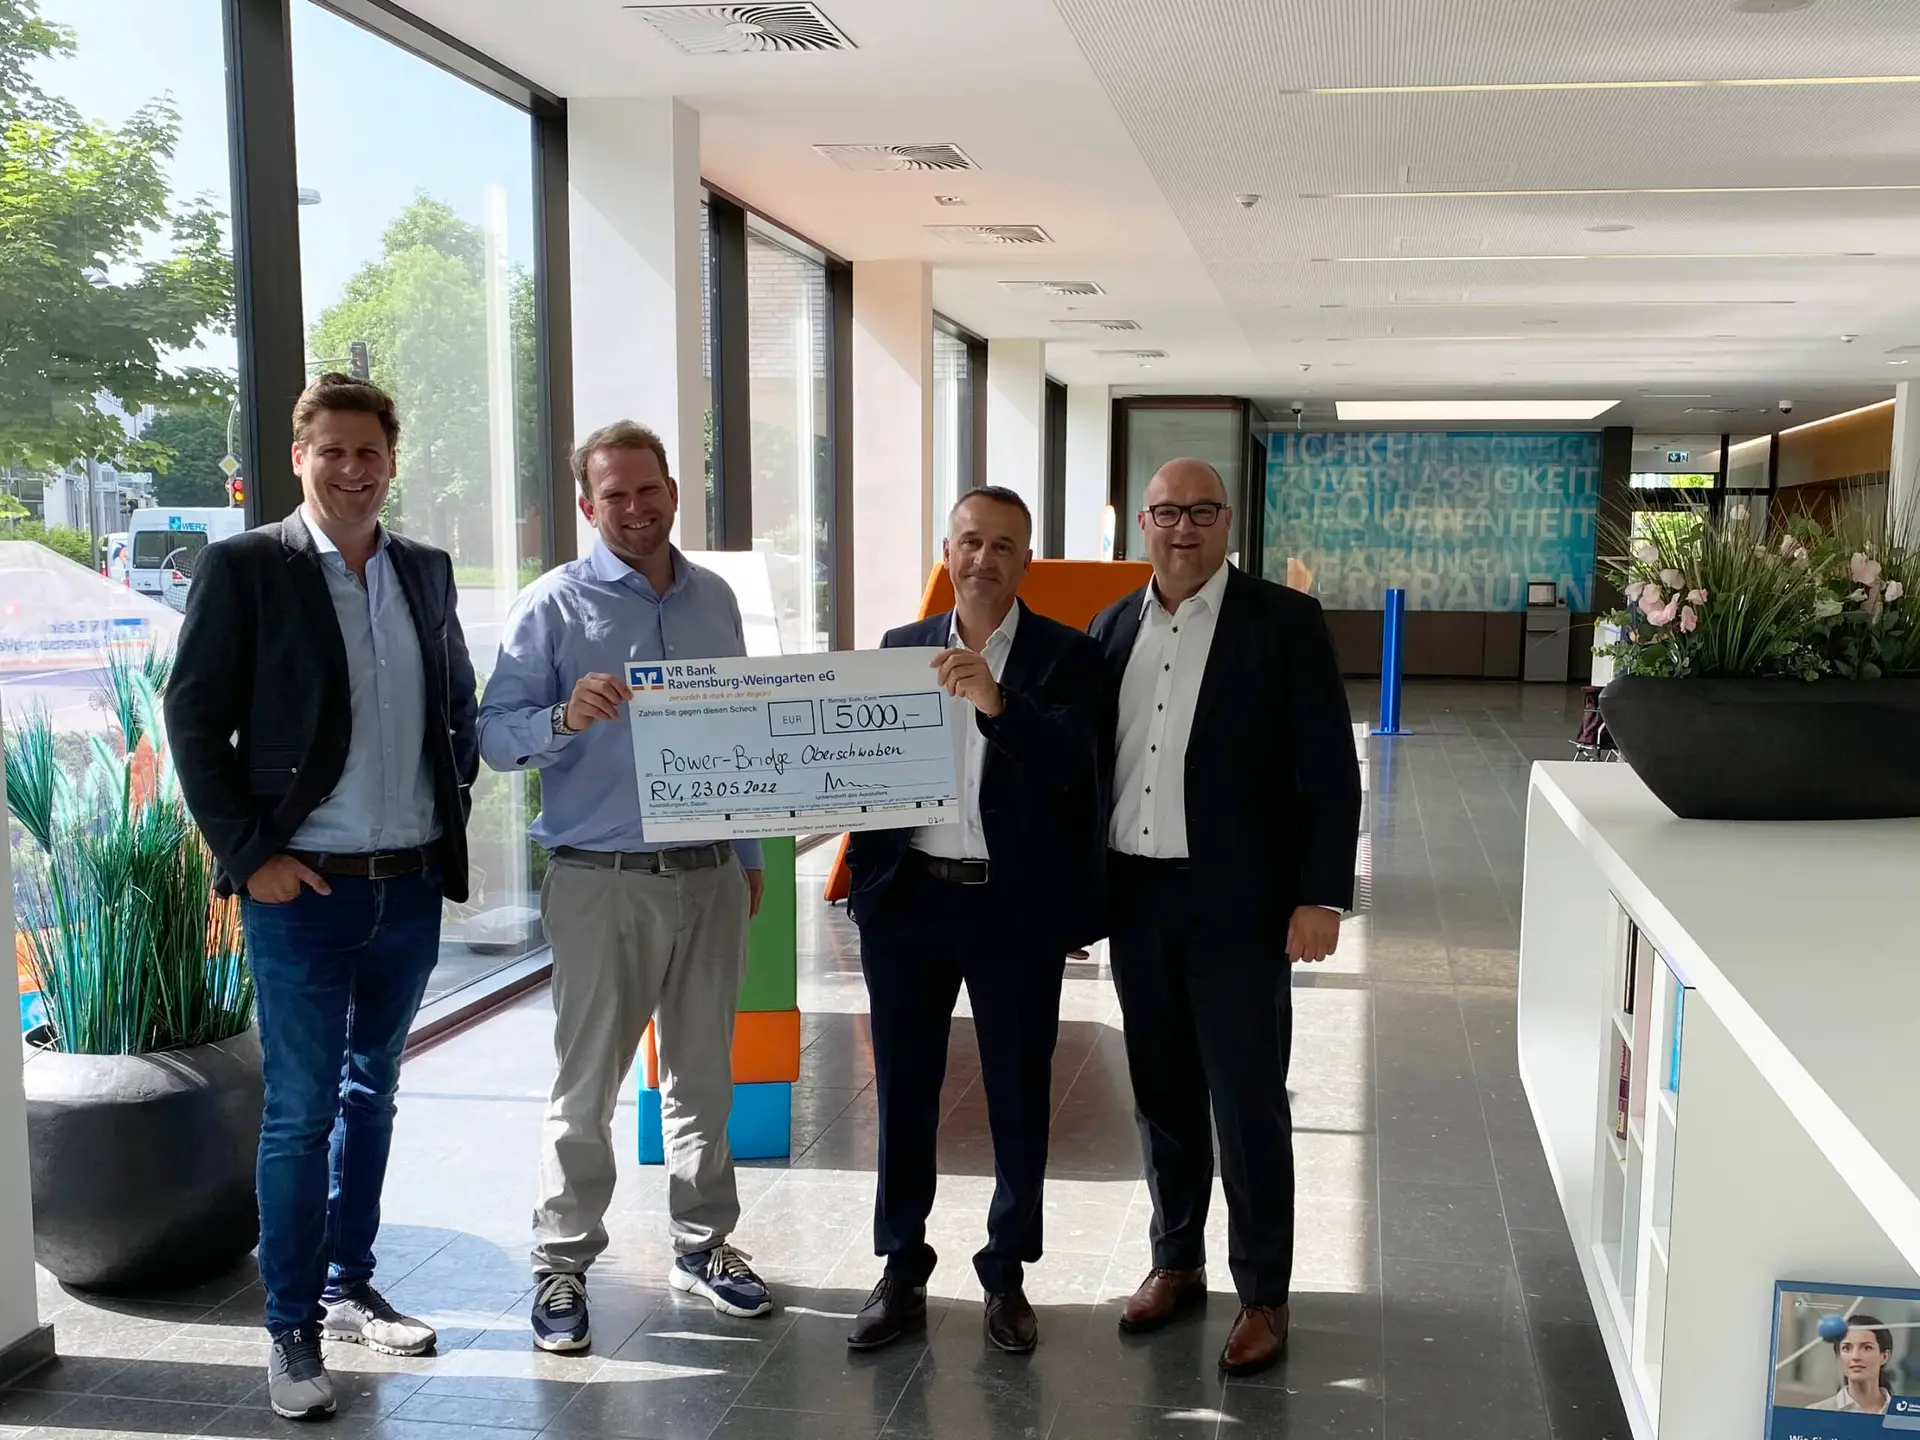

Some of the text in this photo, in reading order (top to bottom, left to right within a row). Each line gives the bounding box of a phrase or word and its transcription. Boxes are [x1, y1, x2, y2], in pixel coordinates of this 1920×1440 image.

[181, 522, 208, 531] WERZ
[666, 664, 717, 677] VR Bank
[668, 670, 836, 690] Ravensburg-Weingarten eG
[638, 705, 758, 717] Zahlen Sie gegen diesen Scheck
[782, 715, 802, 725] EUR
[660, 742, 904, 776] Power-Bridge Oberschwaben
